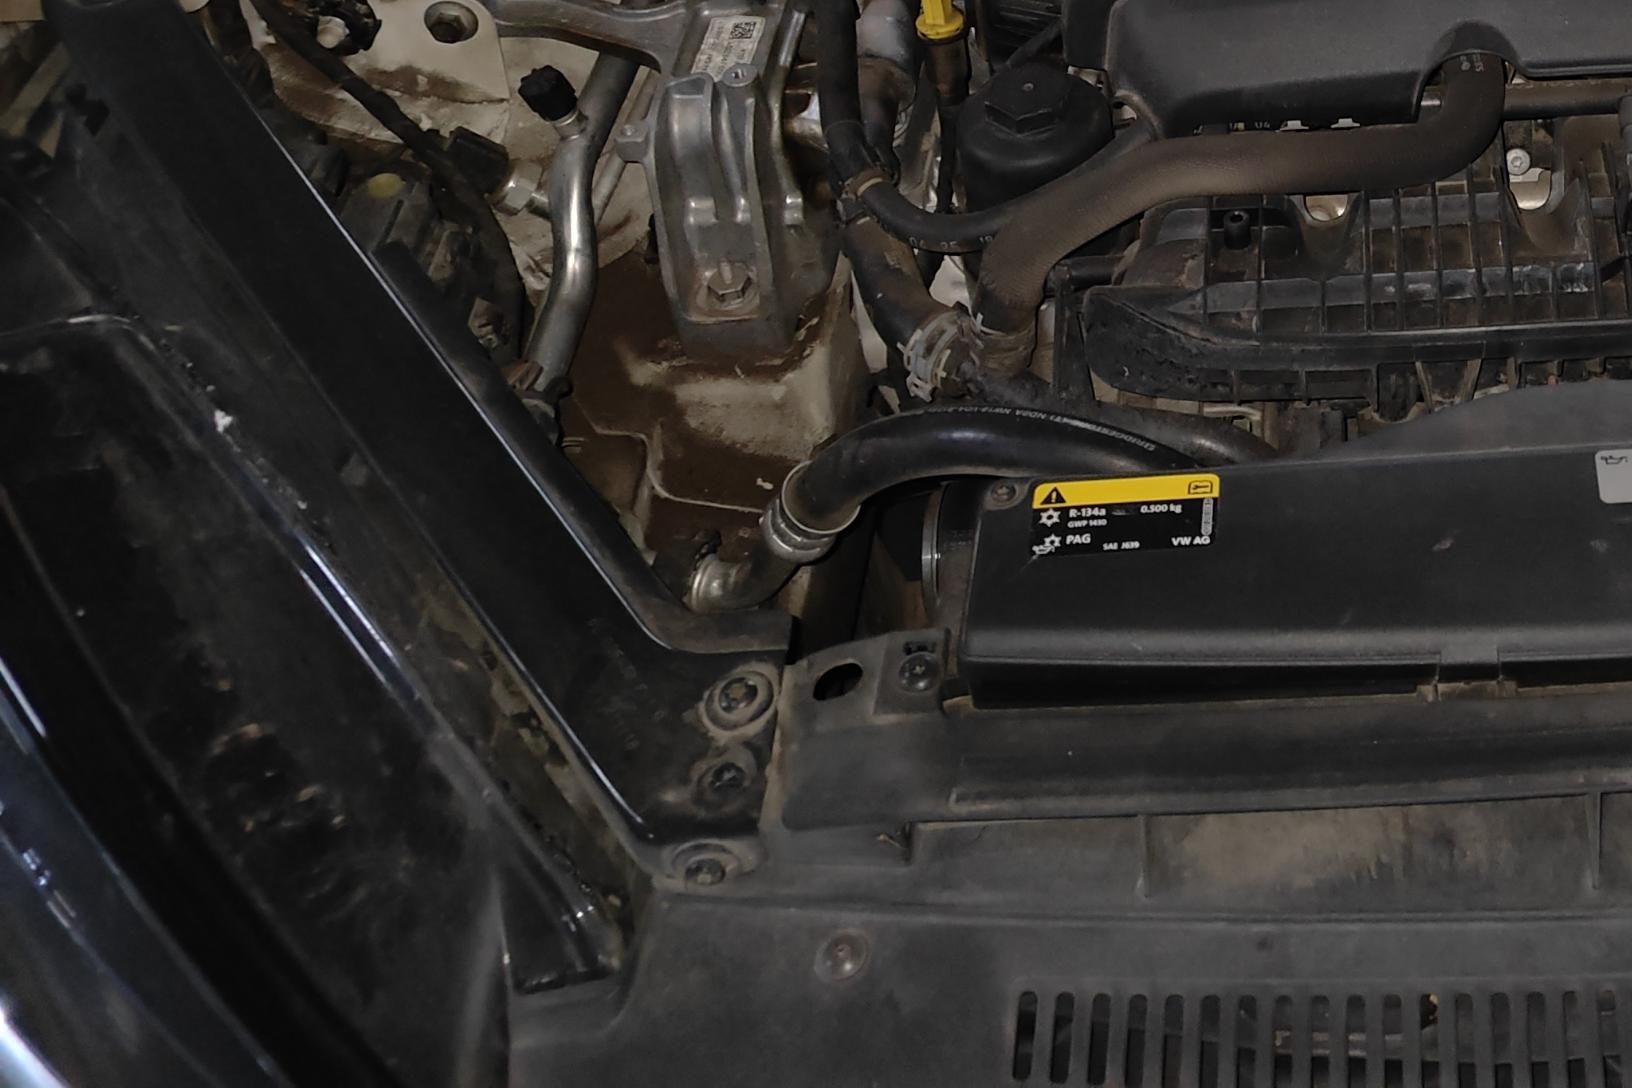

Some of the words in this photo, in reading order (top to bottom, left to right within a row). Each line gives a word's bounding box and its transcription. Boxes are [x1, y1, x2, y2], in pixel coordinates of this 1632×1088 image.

[1069, 507, 1106, 518] R-134a
[1140, 504, 1168, 514] 0.500
[1169, 503, 1182, 514] kg
[1067, 520, 1088, 528] GWP
[1065, 533, 1091, 544] PAG
[1171, 536, 1192, 546] VW
[1193, 535, 1210, 546] AG
[1102, 542, 1118, 551] SAE
